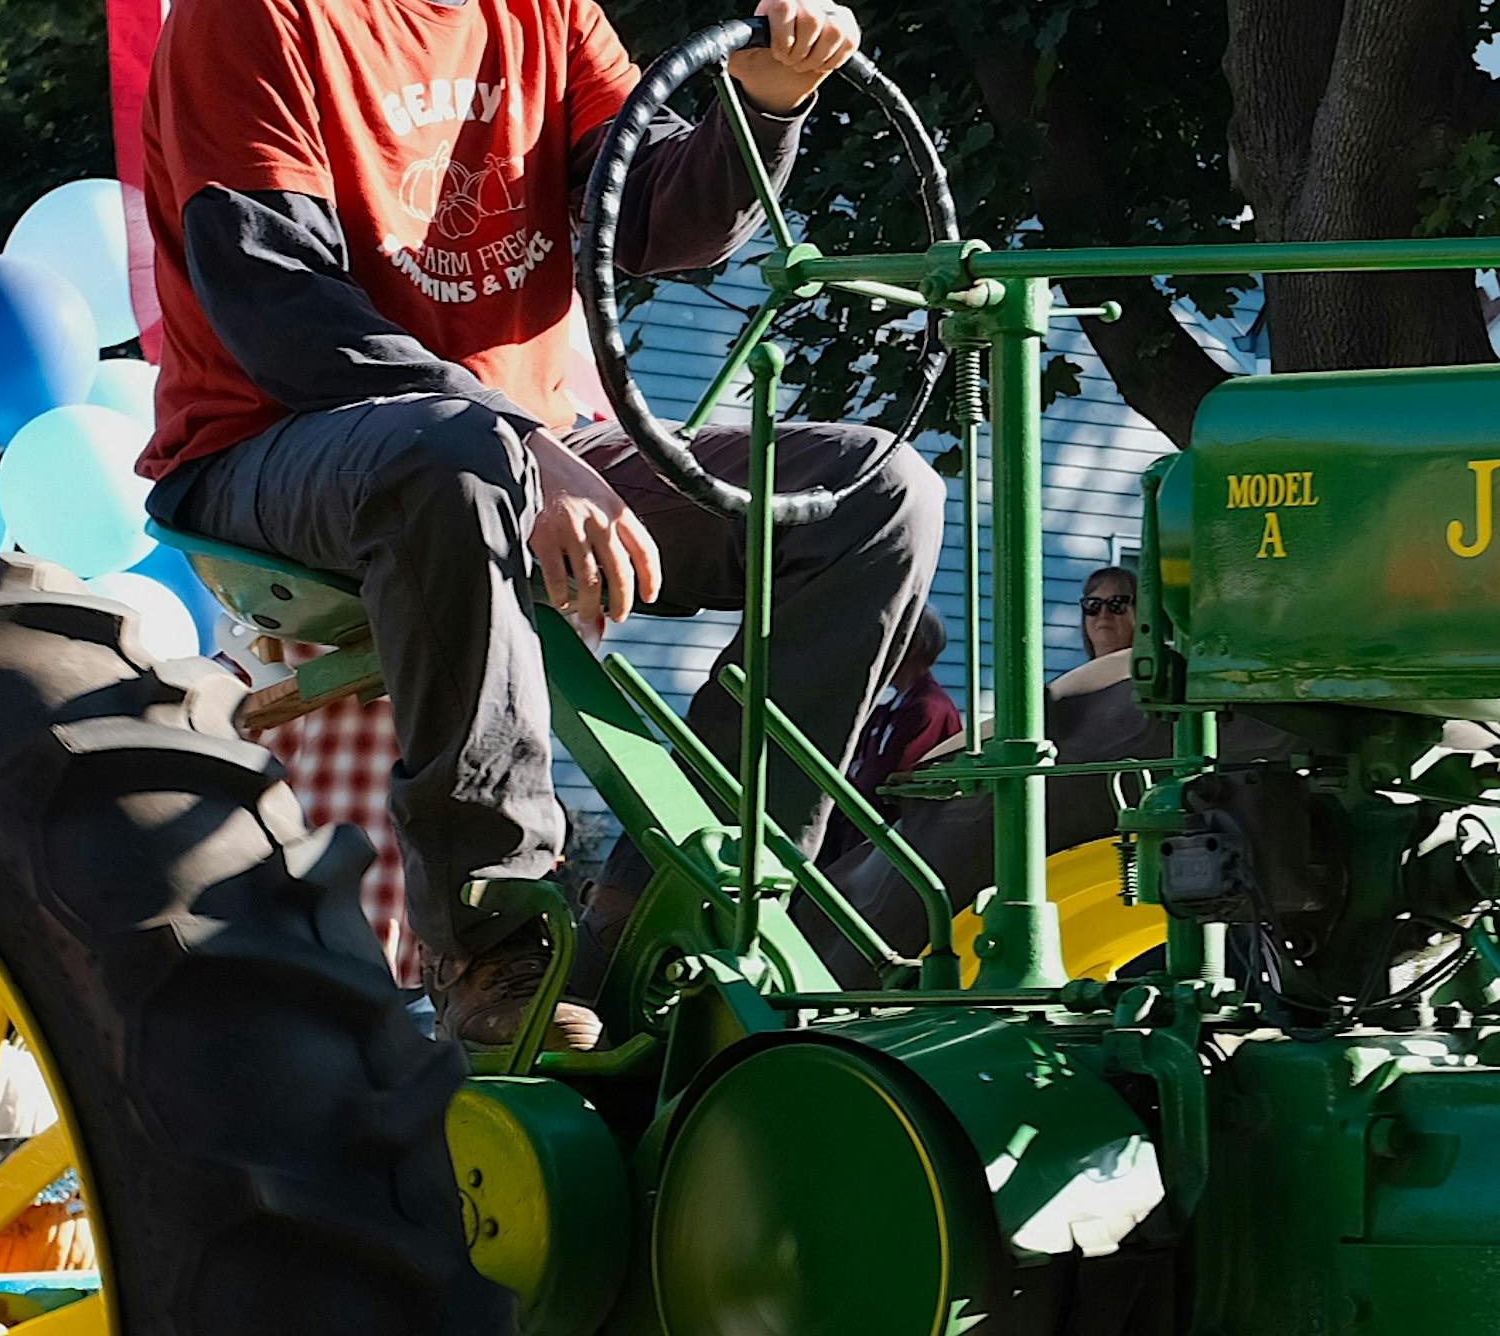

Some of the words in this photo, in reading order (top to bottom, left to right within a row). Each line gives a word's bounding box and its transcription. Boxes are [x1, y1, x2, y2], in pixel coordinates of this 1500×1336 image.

[482, 274, 503, 296] &
[1226, 471, 1320, 509] MODEL
[1256, 512, 1287, 559] A
